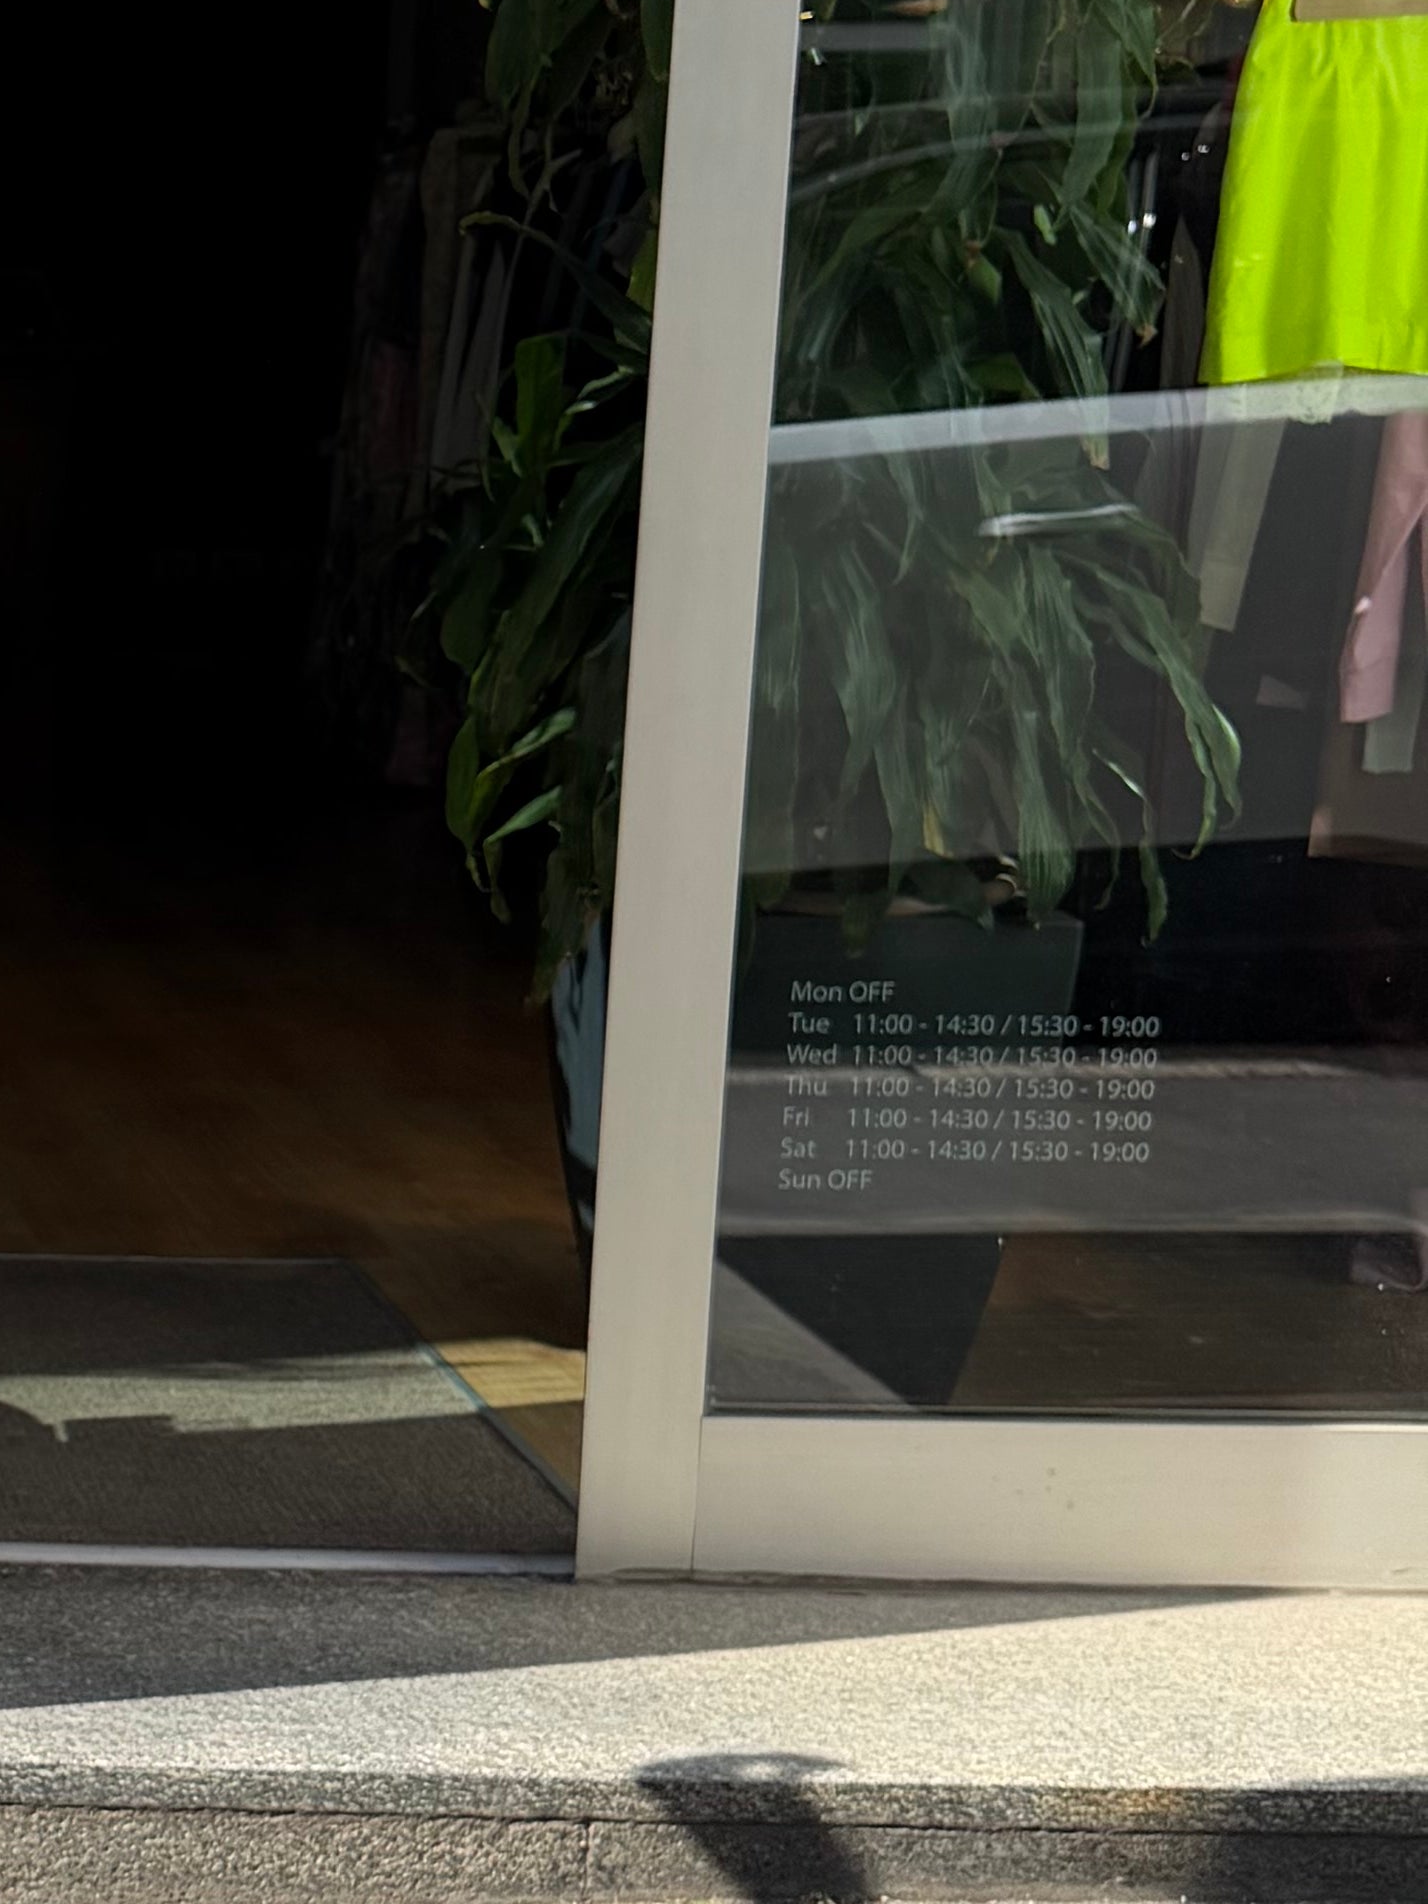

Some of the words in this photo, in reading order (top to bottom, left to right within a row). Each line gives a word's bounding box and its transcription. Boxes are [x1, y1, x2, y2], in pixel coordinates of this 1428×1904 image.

[790, 980, 842, 1003] Mon
[849, 980, 895, 1003] OFF
[788, 1011, 830, 1034] Tue
[854, 1013, 913, 1034] 11:00
[935, 1014, 995, 1036] 14:30
[1018, 1014, 1078, 1037] 15:30
[1099, 1015, 1160, 1038] 19:00
[787, 1043, 837, 1065] Wed
[853, 1045, 912, 1066] 11:00
[934, 1045, 994, 1067] 14:30
[1018, 1047, 1076, 1068] 15:30
[1097, 1047, 1158, 1069] 19:00
[784, 1074, 827, 1096] Thu
[851, 1075, 909, 1097] 11:00
[932, 1076, 991, 1098] 14:30
[1015, 1077, 1074, 1099] 15:30
[1096, 1078, 1155, 1100] 19:00
[783, 1106, 809, 1127] Fri
[848, 1107, 907, 1128] 11:00
[929, 1108, 988, 1129] 14:30
[1011, 1109, 1071, 1131] 15:30
[1093, 1110, 1152, 1132] 19:00
[780, 1137, 816, 1159] Sat
[846, 1138, 905, 1160] 11:00
[927, 1139, 986, 1161] 14:30
[1010, 1141, 1068, 1162] 15:30
[1090, 1142, 1150, 1164] 19:00
[778, 1168, 821, 1190] Sun
[828, 1169, 872, 1191] OFF
